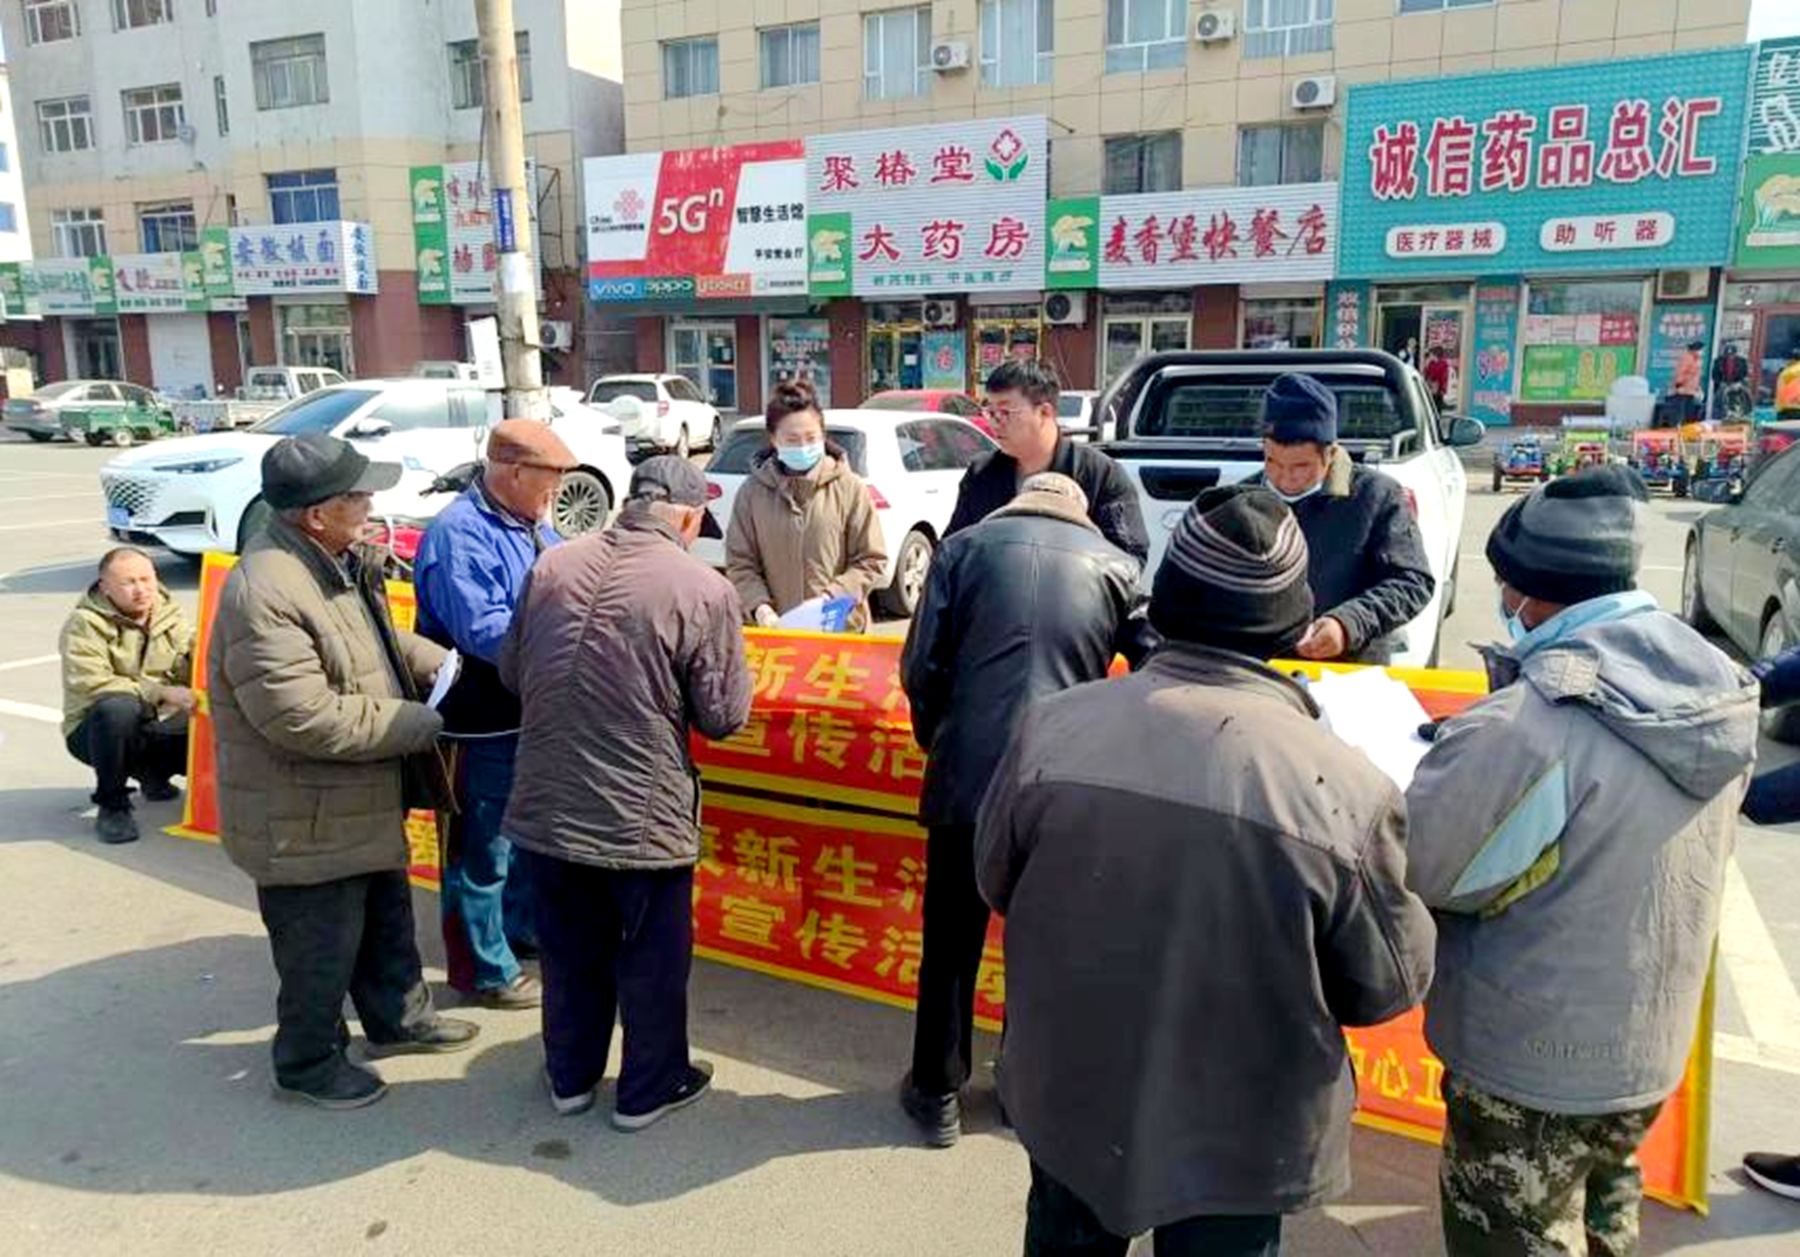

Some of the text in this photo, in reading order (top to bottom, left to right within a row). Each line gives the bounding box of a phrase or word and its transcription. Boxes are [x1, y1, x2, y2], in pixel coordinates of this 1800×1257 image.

[820, 146, 974, 191] 聚椿堂
[1370, 97, 1722, 201] 诚信药品总汇
[737, 203, 804, 224] 智慧生活馆
[1104, 204, 1328, 265] 麦香堡快餐店
[1554, 219, 1658, 245] 助听器
[858, 217, 1030, 262] 大药房
[1395, 227, 1494, 253] 医疗器械
